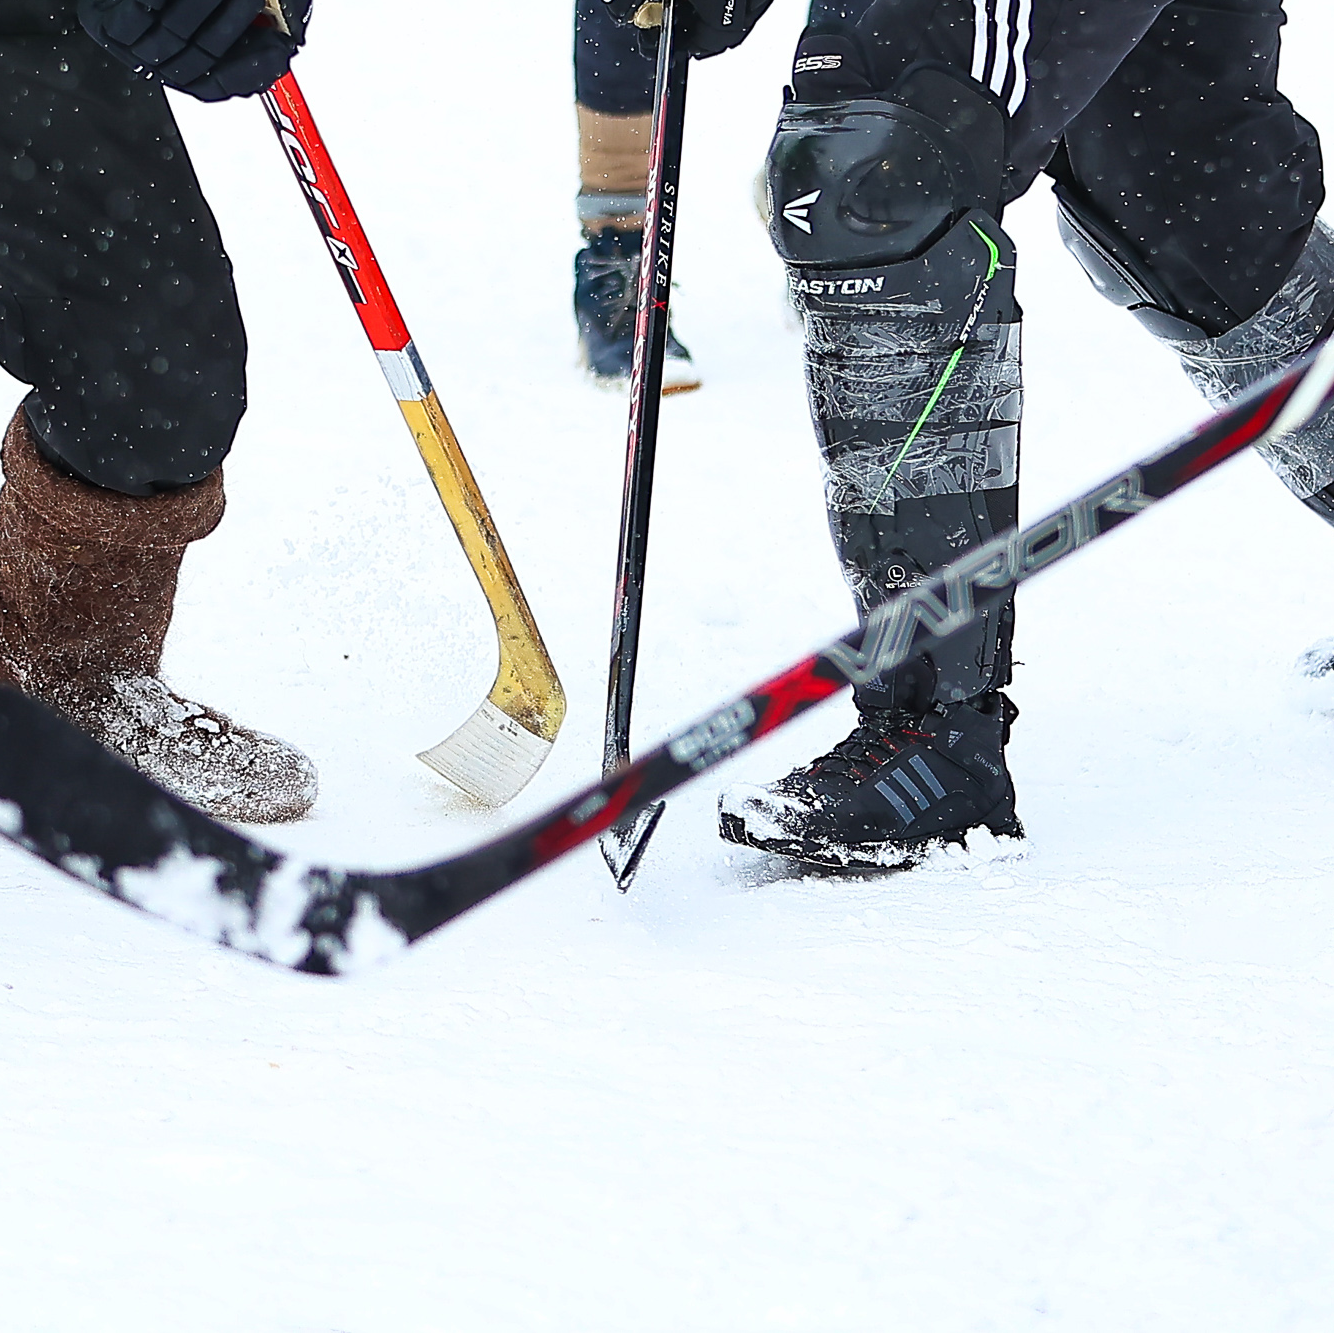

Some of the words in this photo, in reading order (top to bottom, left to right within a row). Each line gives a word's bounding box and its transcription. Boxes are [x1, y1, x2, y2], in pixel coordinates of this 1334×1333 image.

[655, 181, 676, 288] STRIKE
[789, 276, 885, 295] EASTON
[958, 282, 990, 344] STEALTH
[818, 465, 1162, 686] VAPOR
